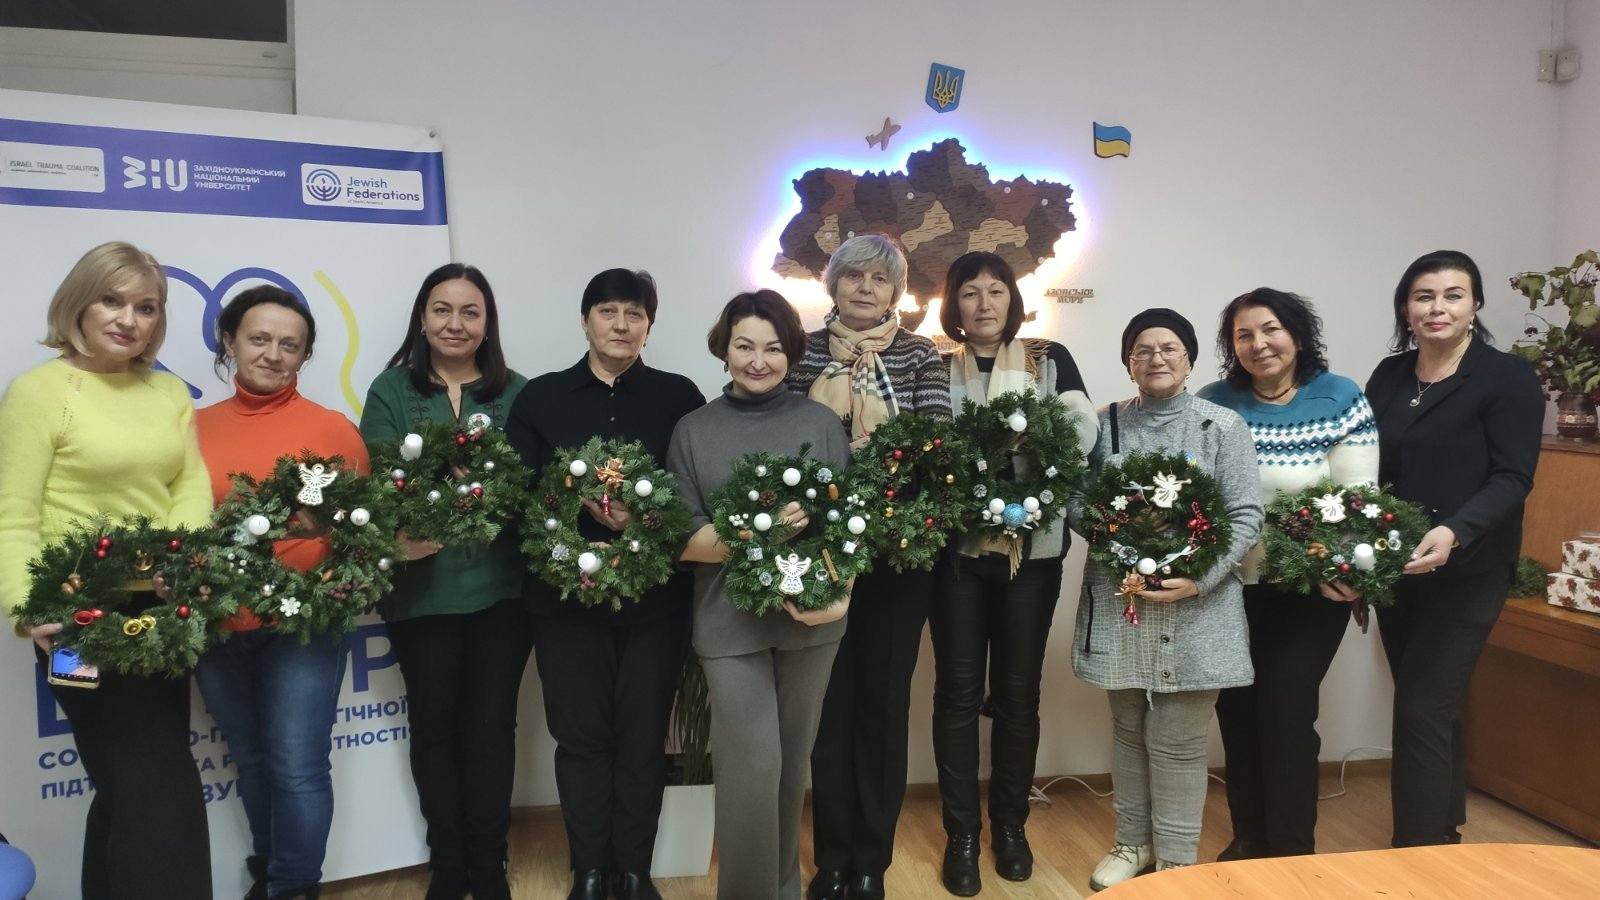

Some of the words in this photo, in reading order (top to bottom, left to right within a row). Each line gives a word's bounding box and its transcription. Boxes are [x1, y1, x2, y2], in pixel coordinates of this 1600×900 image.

[9, 160, 33, 168] ISRAEL
[37, 161, 63, 170] TRAUMA
[66, 164, 100, 172] COALITION
[193, 164, 286, 177] ЗАХІДНОУКРАЇНСЬКИЙ
[194, 173, 260, 184] НАЦІОНАЛЬНИЙ
[347, 176, 388, 188] Jewish
[195, 181, 251, 191] УНІВЕРСИТЕТ
[346, 187, 420, 201] Federations
[333, 726, 407, 750] ТНОСТІ
